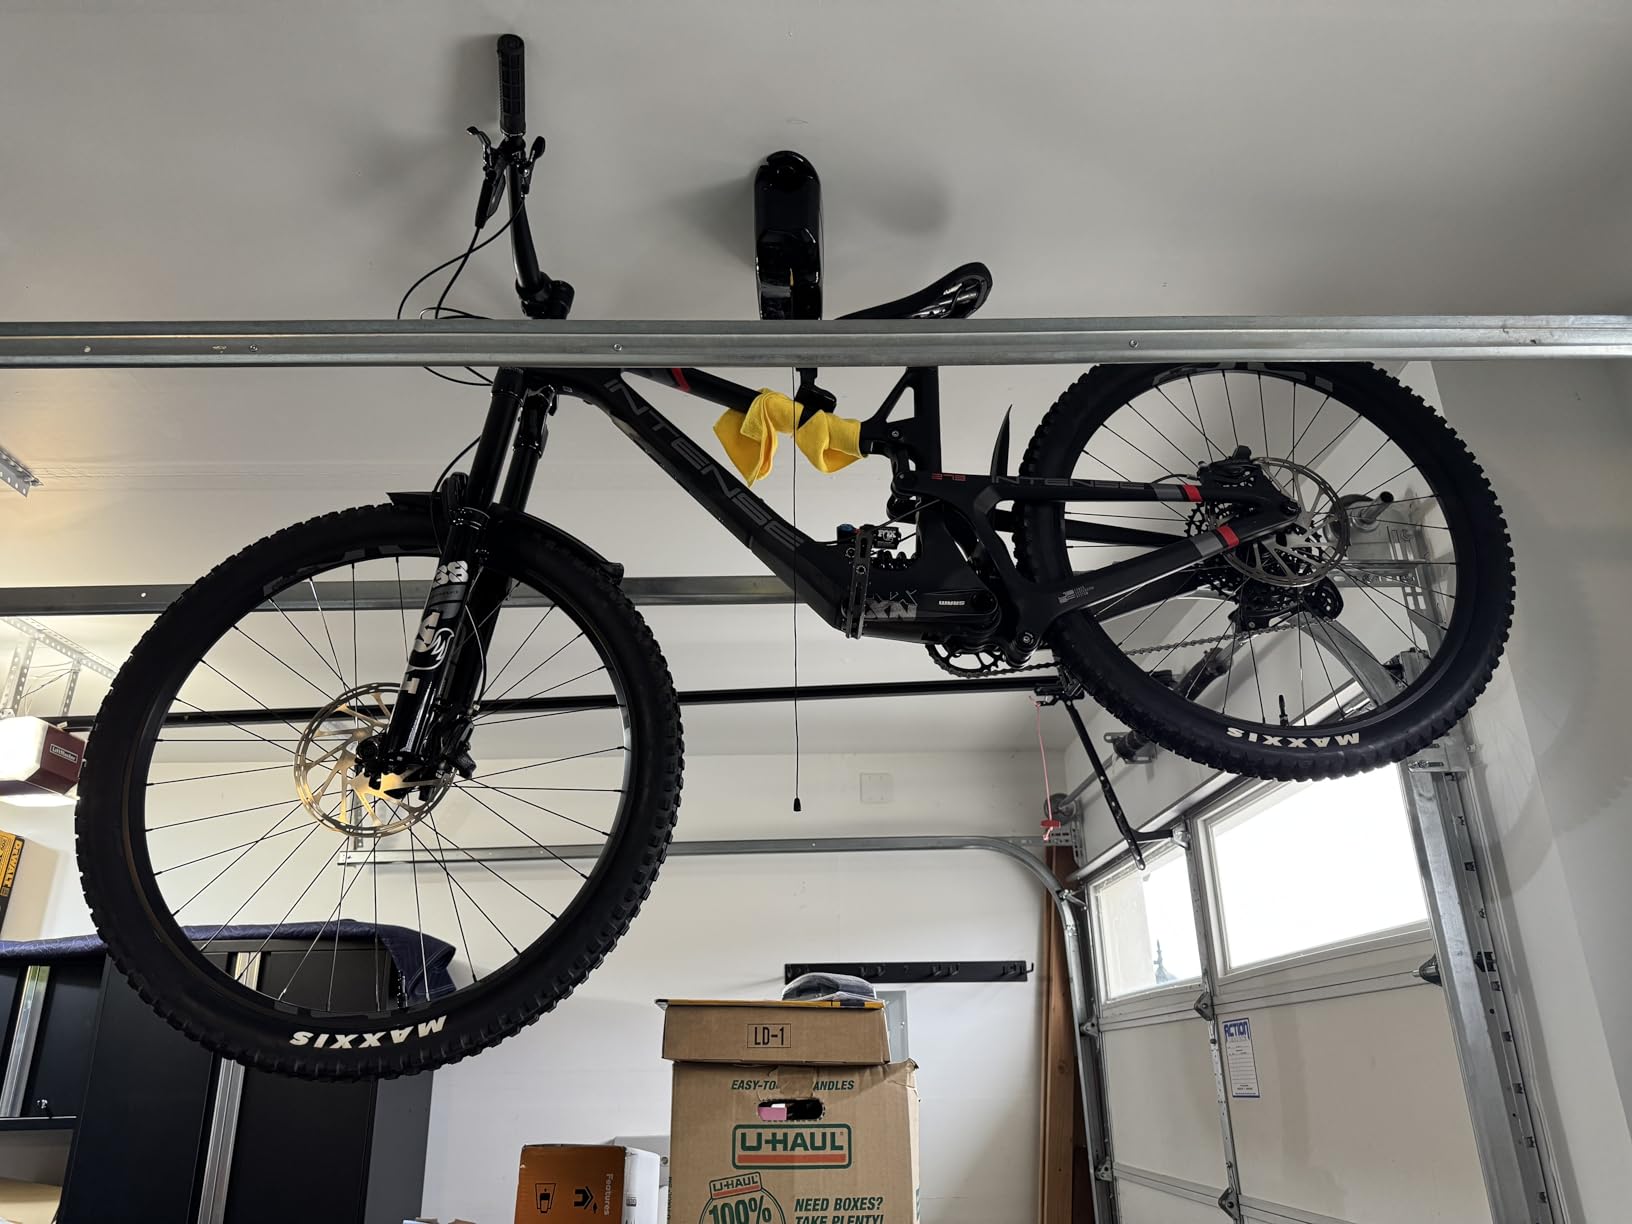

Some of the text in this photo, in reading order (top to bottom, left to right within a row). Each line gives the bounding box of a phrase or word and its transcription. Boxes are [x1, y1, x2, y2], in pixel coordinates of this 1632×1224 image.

[605, 379, 805, 551] INTENSE
[991, 475, 1145, 490] INTENSE
[877, 529, 897, 541] FOX
[1226, 727, 1360, 748] MAXXIS
[289, 1015, 447, 1049] MAXXIS
[754, 1026, 785, 1046] LD-1
[1223, 1020, 1250, 1040] ACTION
[731, 1079, 855, 1091] EASY-TO ANDLES
[740, 1131, 844, 1152] U-HAUL
[712, 1175, 759, 1192] U-HAUL
[603, 1173, 614, 1216] Features
[794, 1197, 883, 1212] NEED BOXES?
[708, 1195, 772, 1224] 100%
[795, 1215, 828, 1224] TAKE
